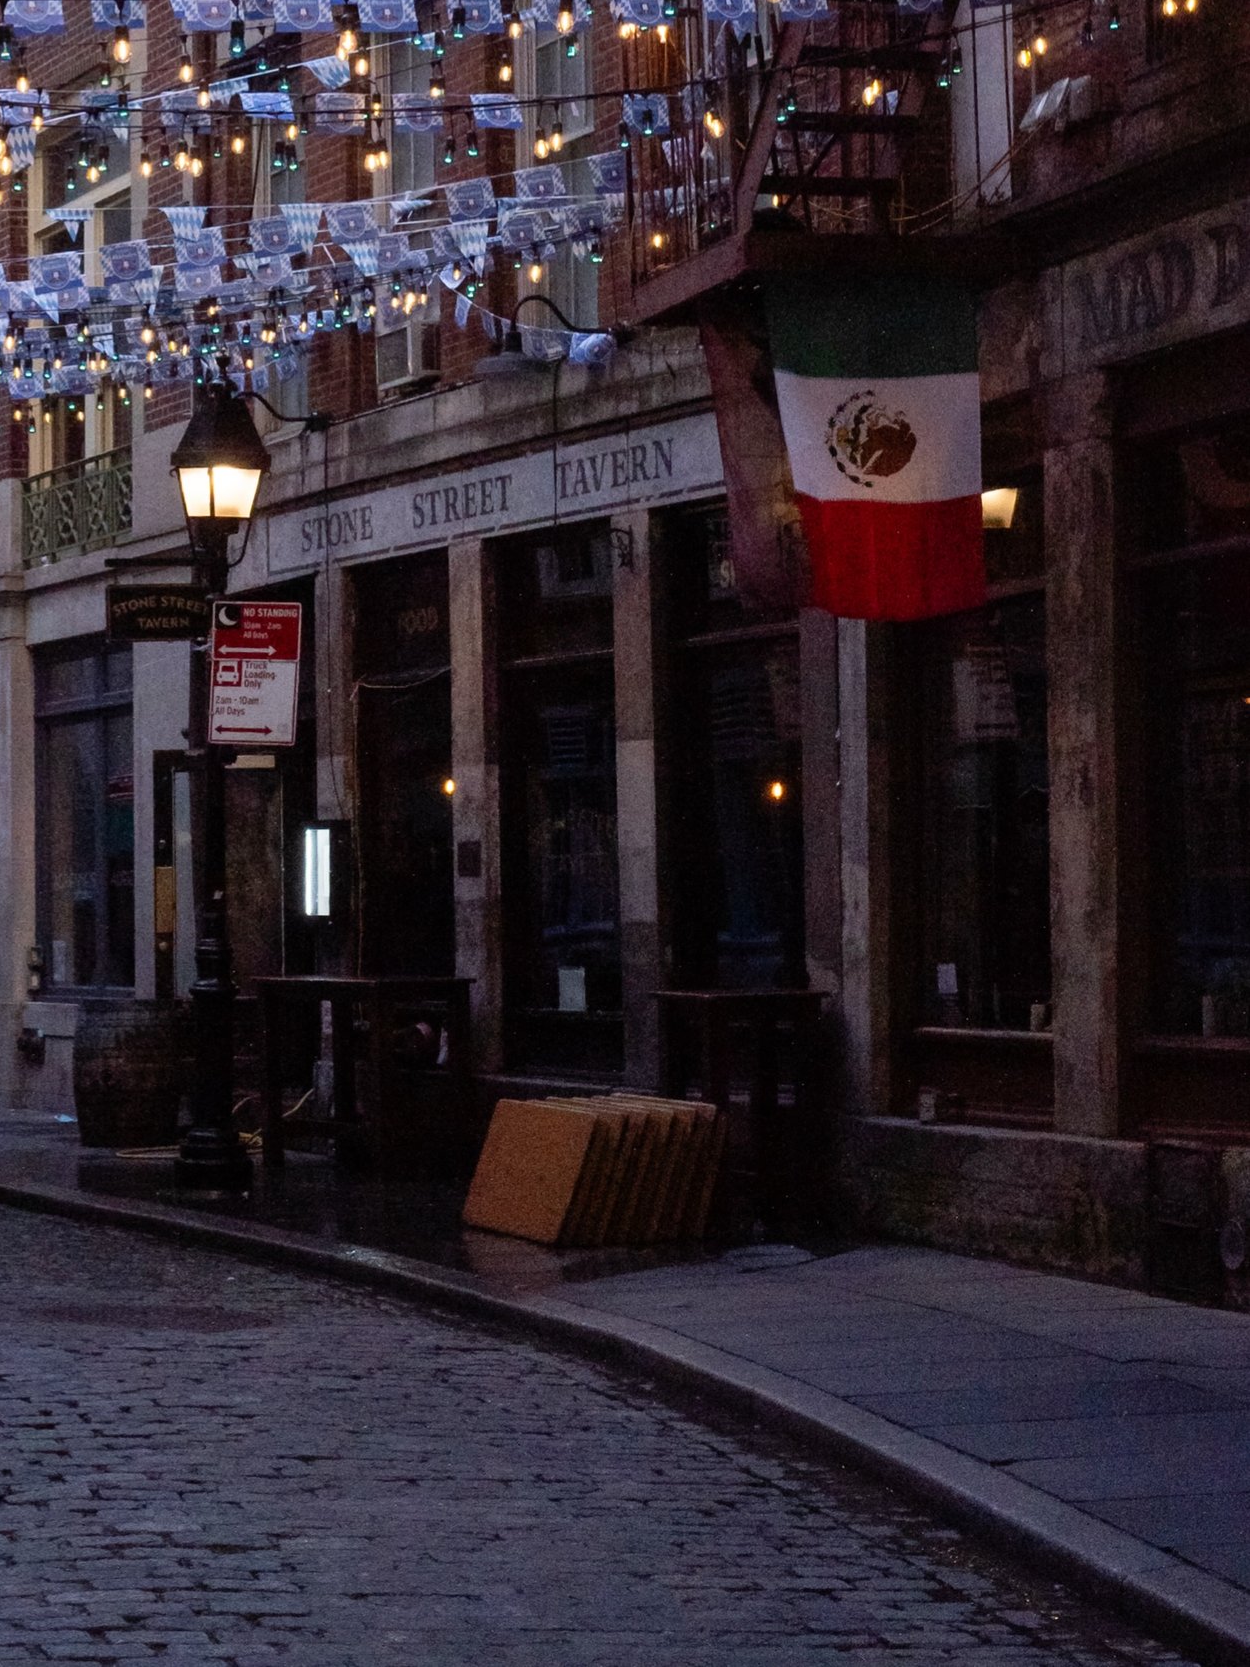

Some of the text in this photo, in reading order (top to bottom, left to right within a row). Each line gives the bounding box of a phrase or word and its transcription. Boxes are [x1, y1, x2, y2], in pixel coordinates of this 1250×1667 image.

[301, 438, 674, 553] STONE STREET TAVERN
[111, 595, 208, 617] STONE STREET
[243, 607, 298, 618] NO STANDING
[137, 616, 190, 631] TAVERN
[245, 661, 268, 669] Truck
[244, 670, 276, 680] Loading
[244, 679, 262, 689] Only
[216, 695, 232, 704] 2am
[239, 696, 260, 705] 10am
[215, 706, 246, 716] All Days
